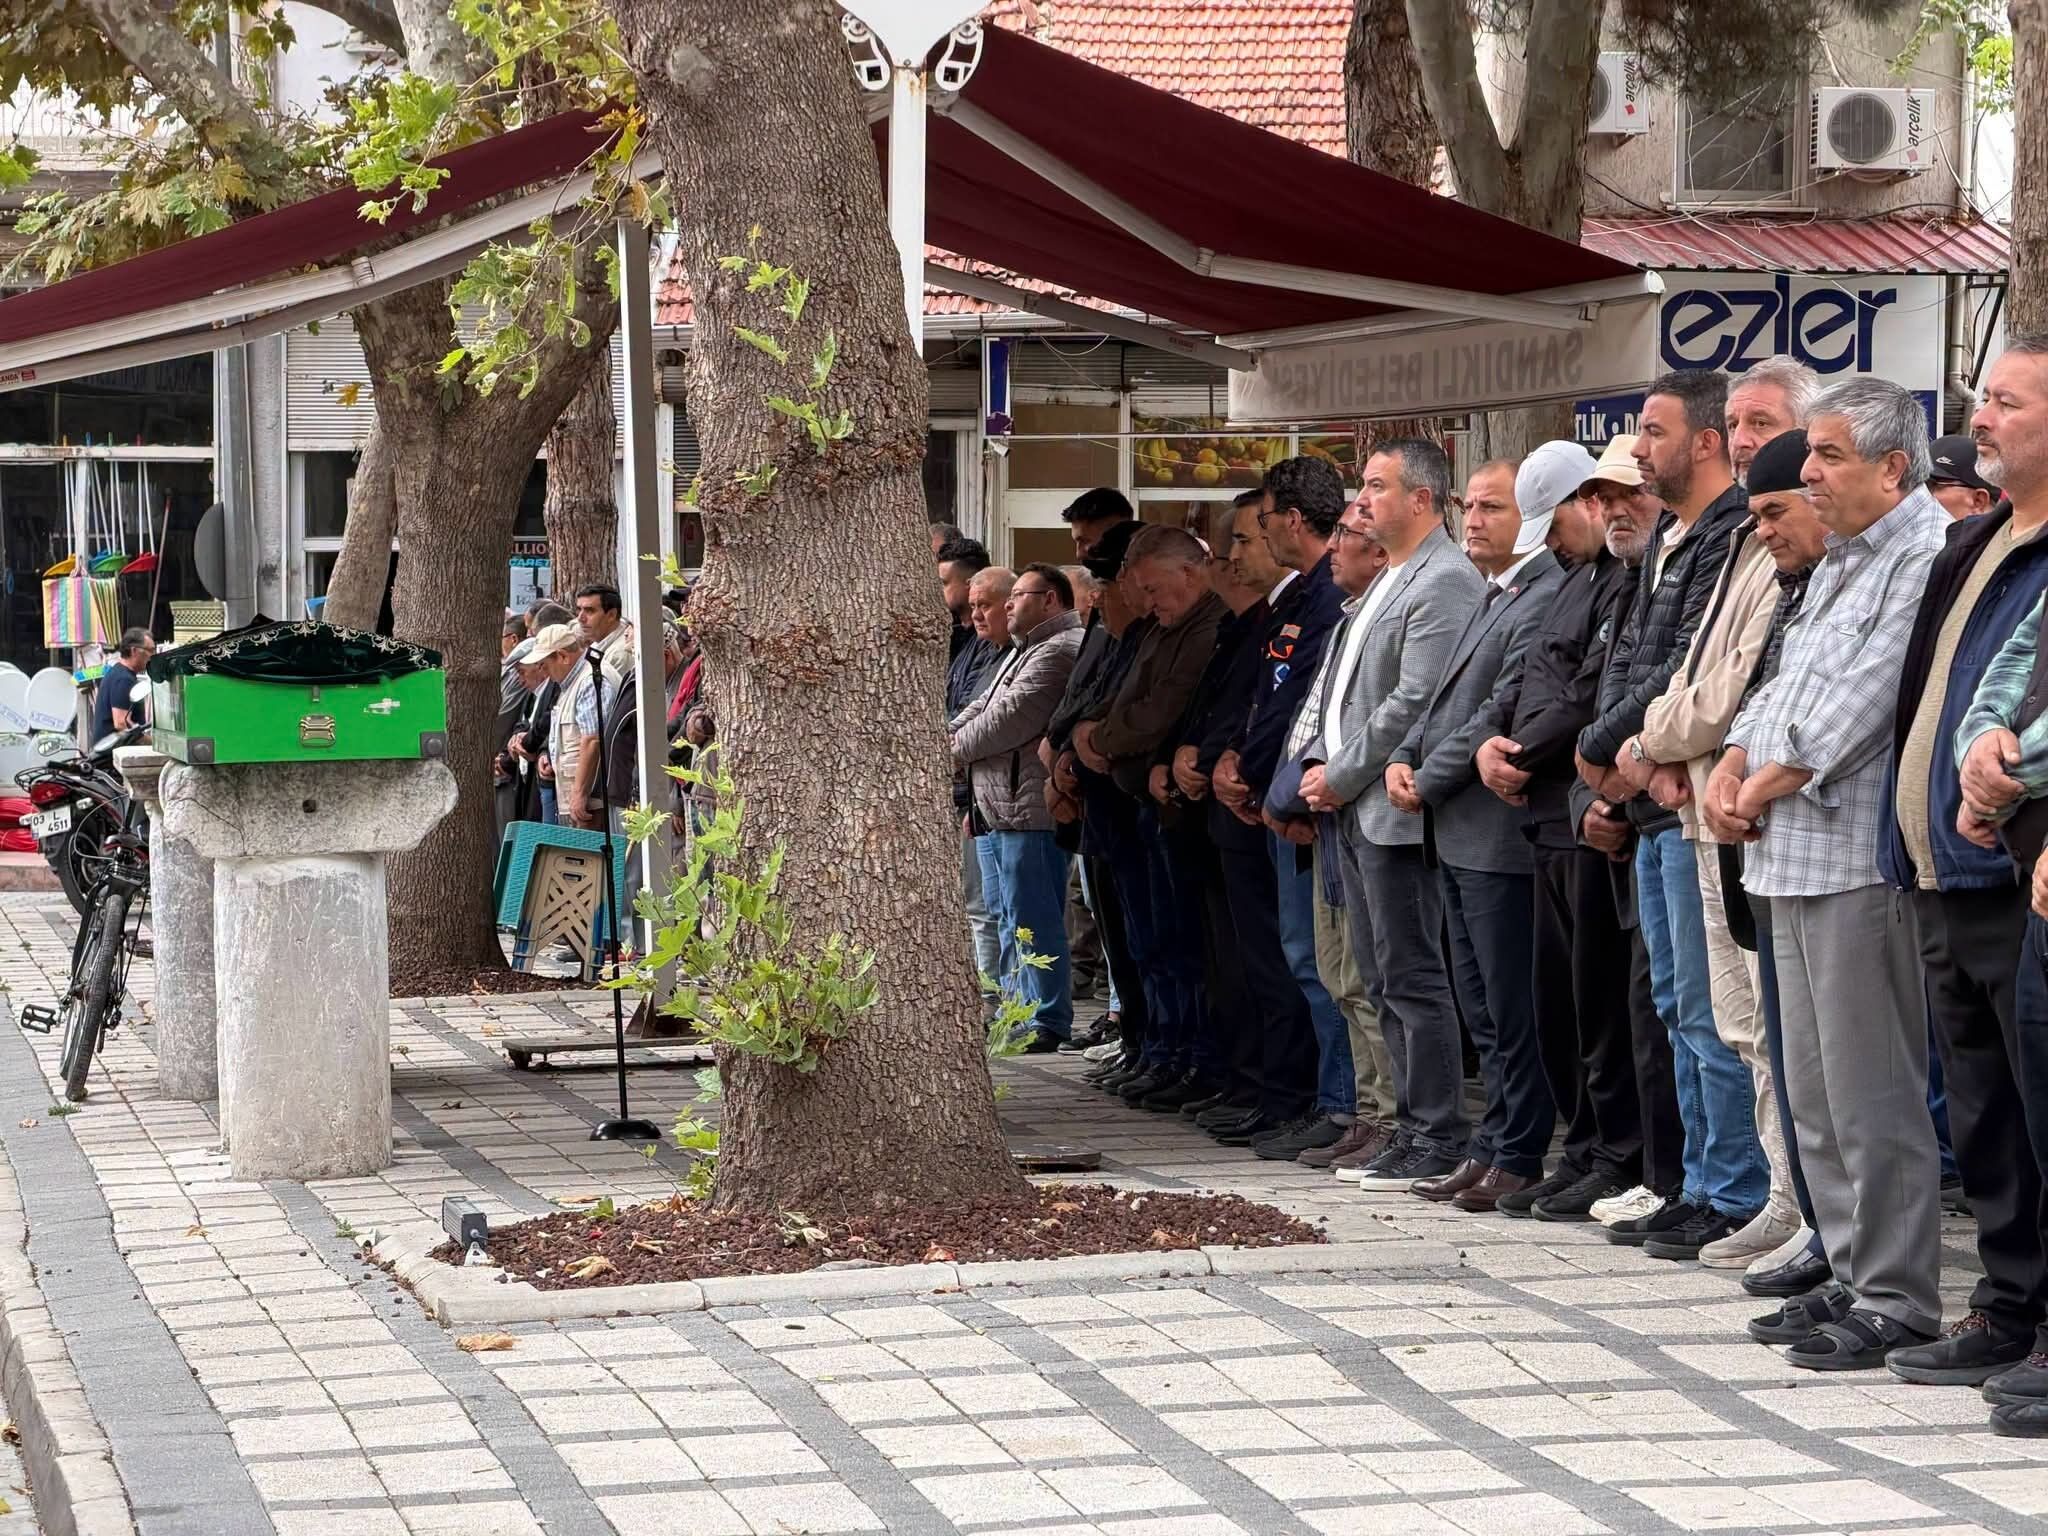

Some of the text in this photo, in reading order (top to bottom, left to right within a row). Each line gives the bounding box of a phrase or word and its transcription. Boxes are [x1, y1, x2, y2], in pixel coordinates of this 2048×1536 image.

[1907, 95, 1922, 147] arçelik
[33, 811, 60, 826] 03 L
